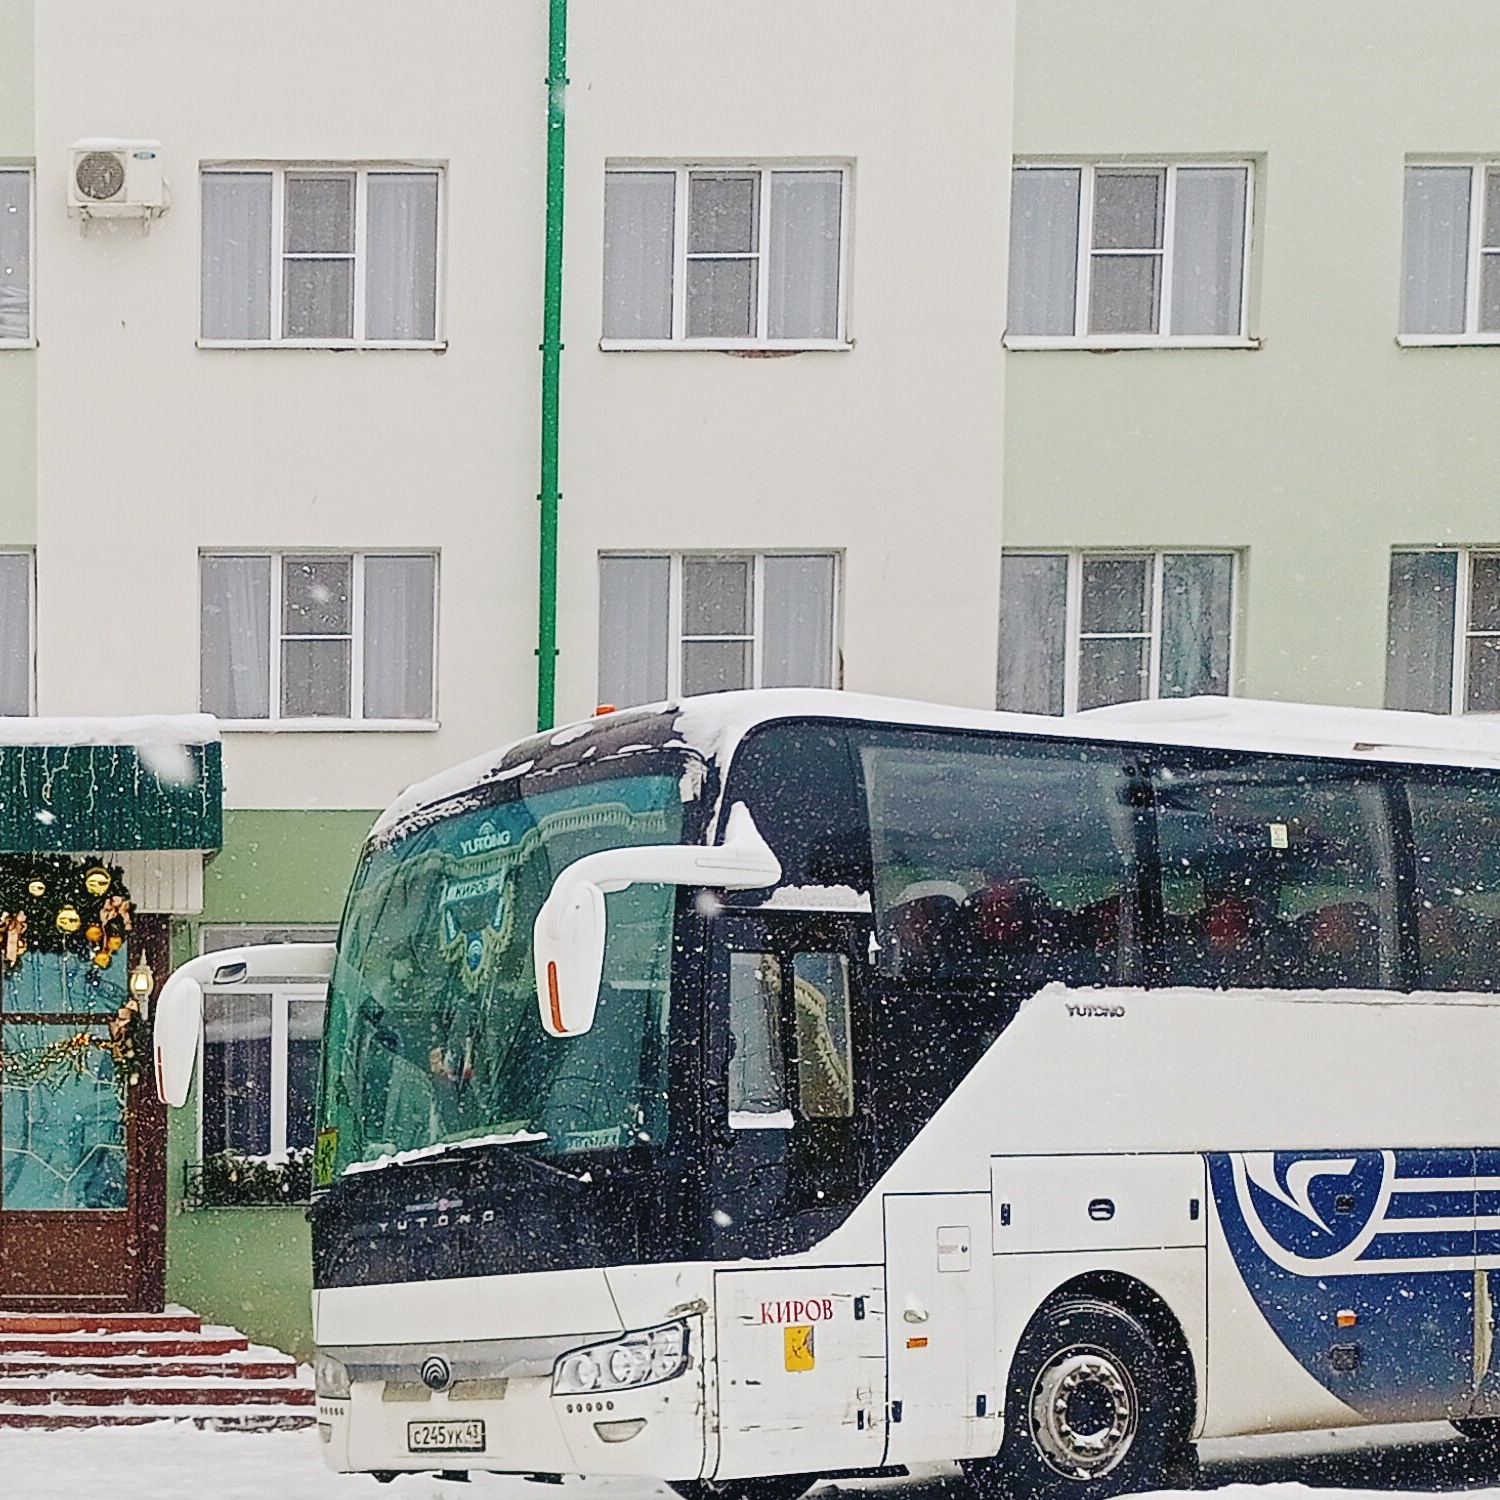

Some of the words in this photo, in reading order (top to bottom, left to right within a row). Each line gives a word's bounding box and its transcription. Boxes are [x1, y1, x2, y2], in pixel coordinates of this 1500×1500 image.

[460, 830, 511, 855] YUTONG
[378, 1209, 495, 1233] YUTONG
[760, 1298, 833, 1324] КИРОВ
[466, 1424, 479, 1439] 43
